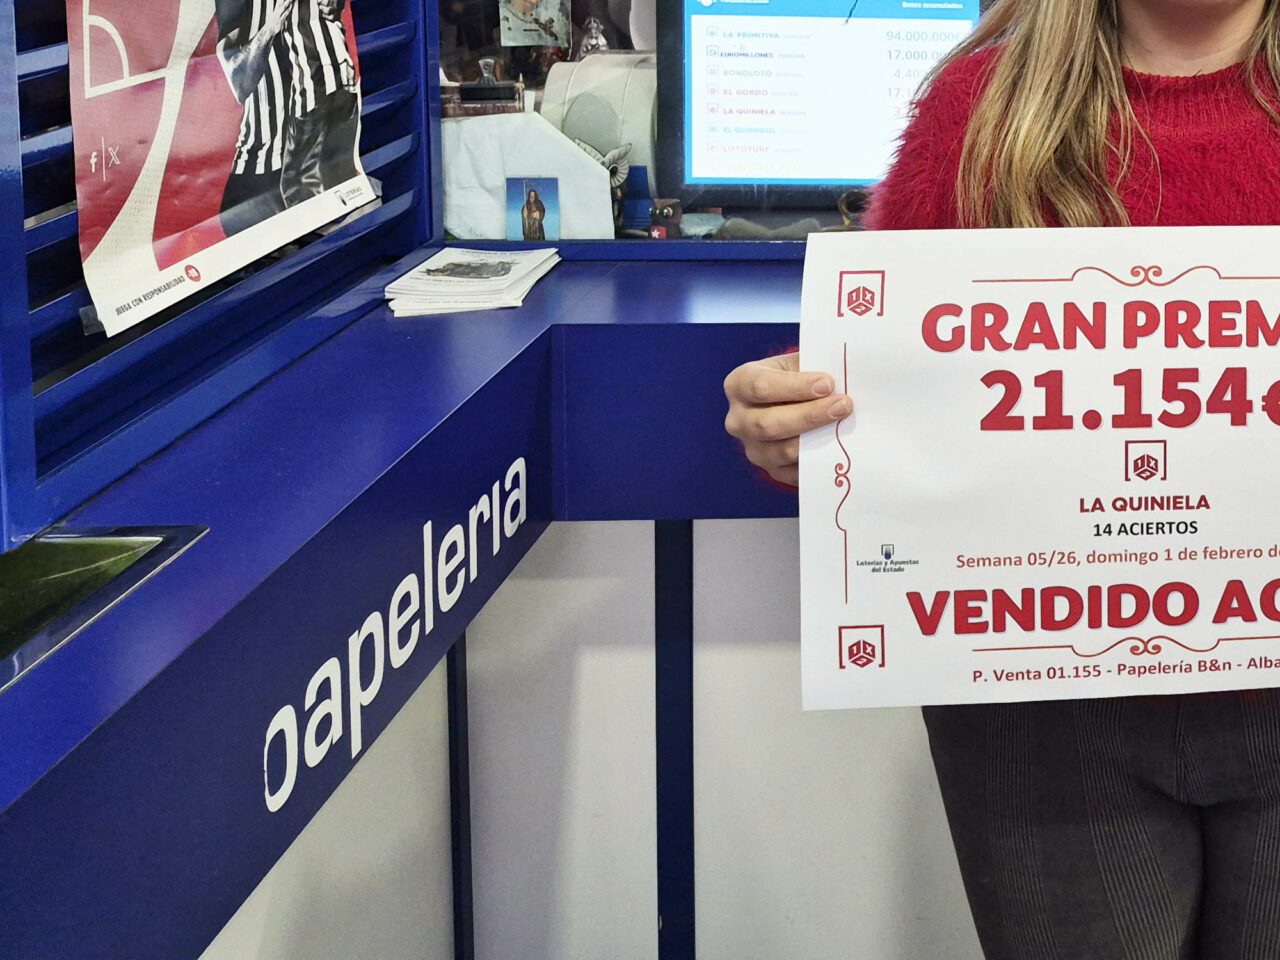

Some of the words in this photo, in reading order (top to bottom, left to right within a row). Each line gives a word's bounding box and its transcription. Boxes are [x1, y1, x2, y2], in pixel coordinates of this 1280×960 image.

[921, 300, 1107, 353] GRAN
[1079, 497, 1106, 514] LA
[1111, 494, 1211, 514] QUINIELA
[1093, 522, 1113, 537] 14
[1117, 520, 1198, 537] ACIERTOS
[956, 553, 1022, 568] Semana
[1027, 550, 1081, 568] 05/26,
[1086, 548, 1159, 567] domingo
[1164, 548, 1173, 561] 1
[1178, 547, 1198, 560] de
[1202, 545, 1263, 559] febrero
[906, 581, 1200, 637] VENDIDO
[973, 670, 988, 683] P.
[993, 668, 1042, 681] Venta
[1046, 664, 1101, 681] 01.155
[1117, 660, 1193, 678] Papelería
[1197, 659, 1231, 673] B&n
